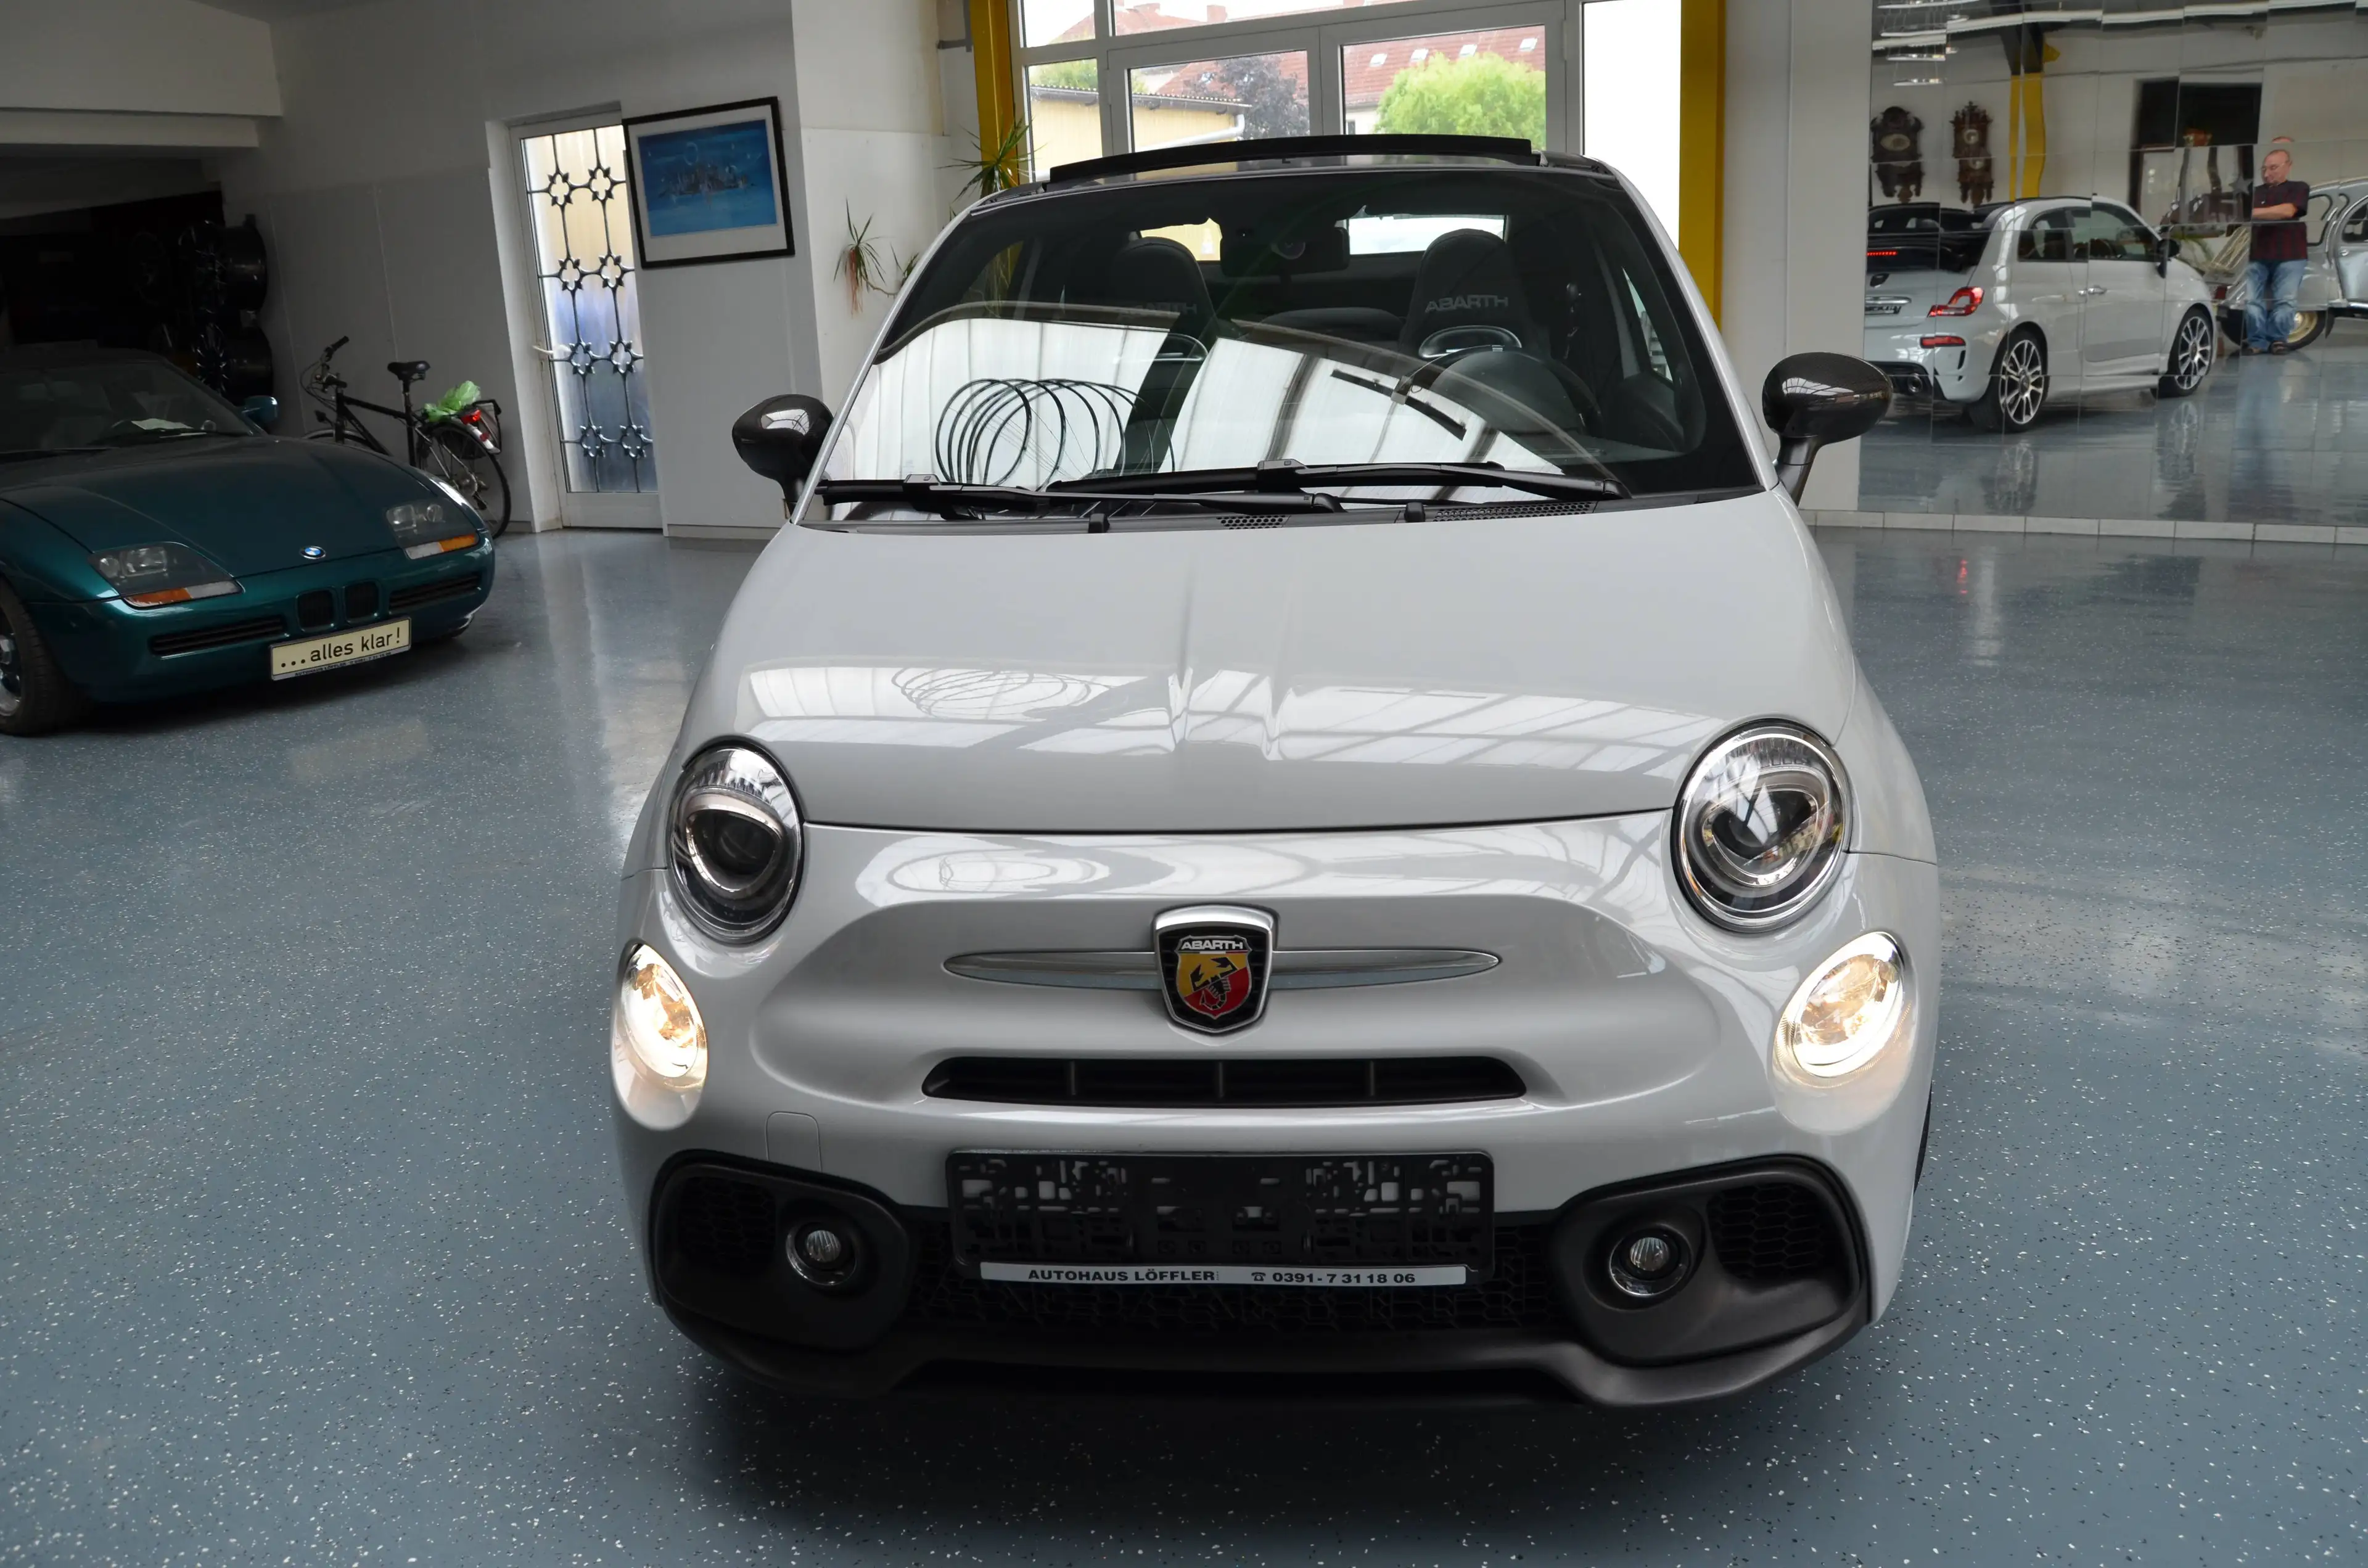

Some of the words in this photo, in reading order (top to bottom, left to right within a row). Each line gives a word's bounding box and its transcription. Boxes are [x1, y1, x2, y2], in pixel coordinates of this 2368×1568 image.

[1424, 294, 1508, 313] ABARTH
[1182, 940, 1243, 950] ABARTH
[1028, 1269, 1128, 1281] AUTOHAUS
[1135, 1268, 1215, 1281] LÖFFLER
[1393, 1273, 1416, 1283] 06
